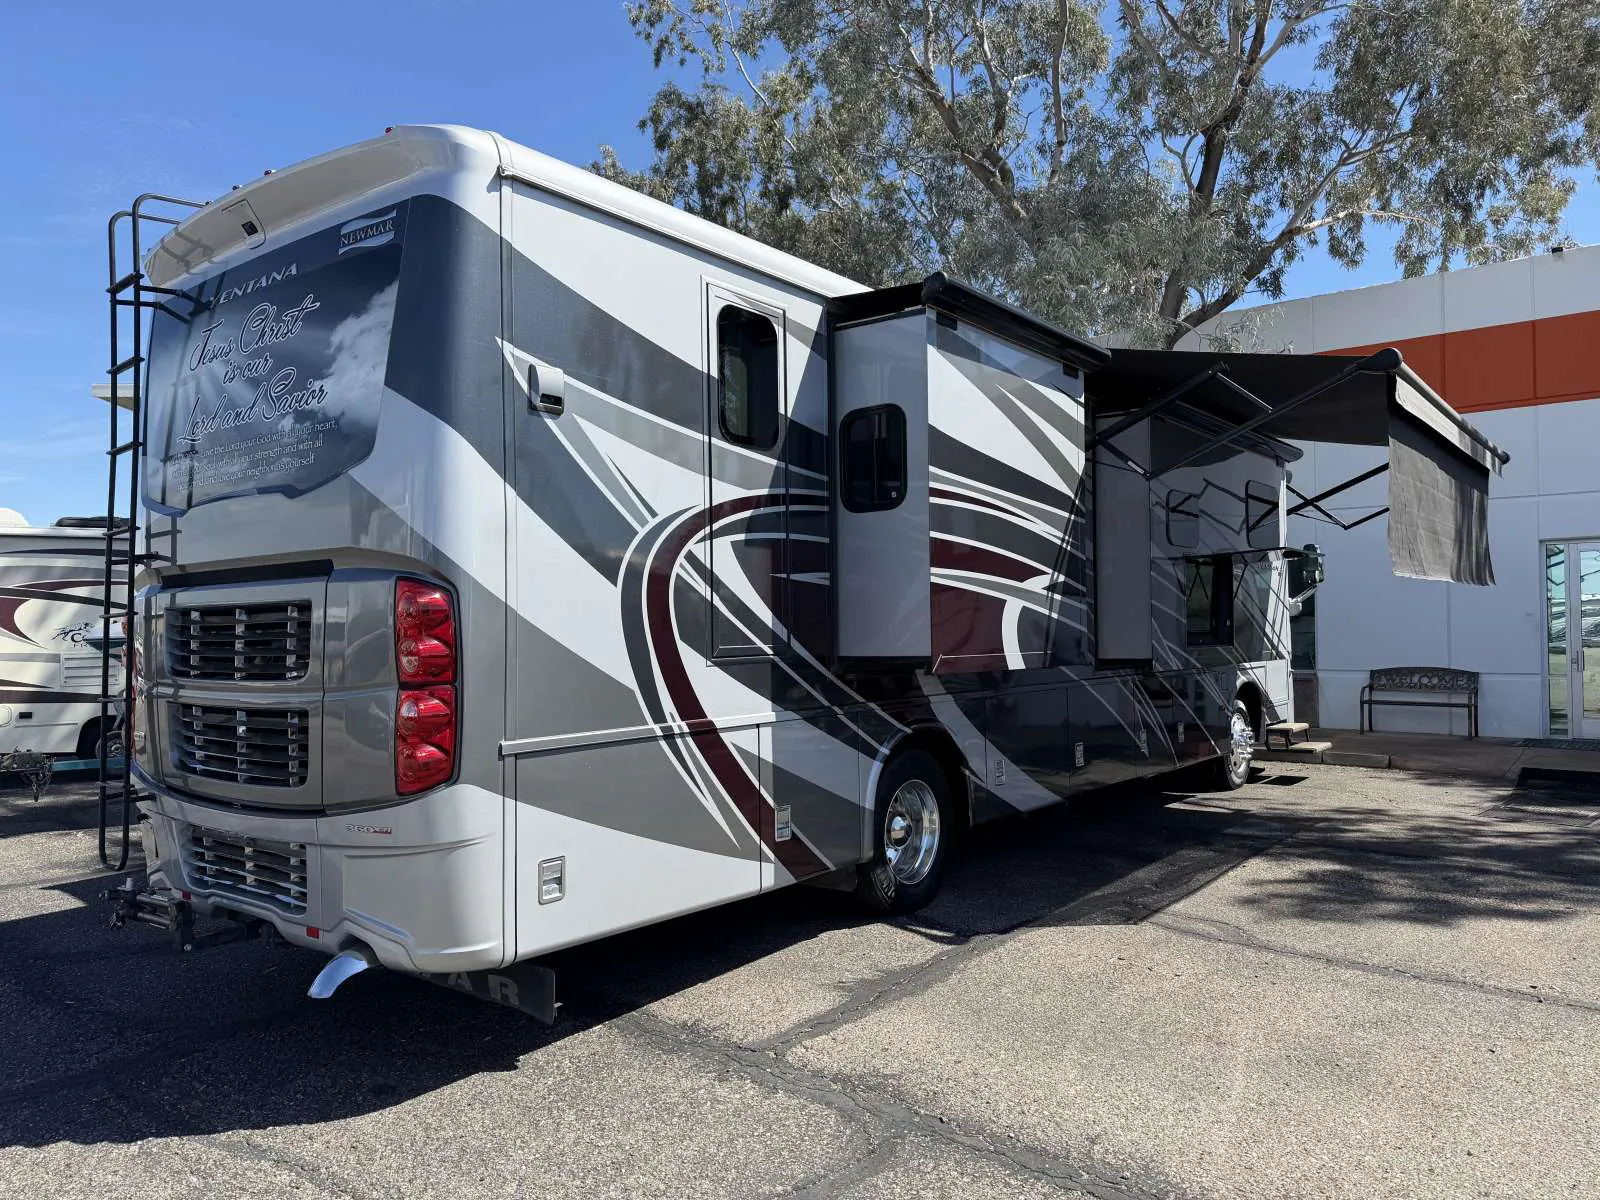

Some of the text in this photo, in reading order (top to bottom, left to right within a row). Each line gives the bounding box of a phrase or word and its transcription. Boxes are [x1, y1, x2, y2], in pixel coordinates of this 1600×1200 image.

[340, 219, 393, 247] NEWMAR
[209, 262, 298, 309] VENTANA
[189, 293, 321, 372] Jesus Christ
[223, 352, 273, 385] is our
[177, 366, 329, 444] Lord and Savior
